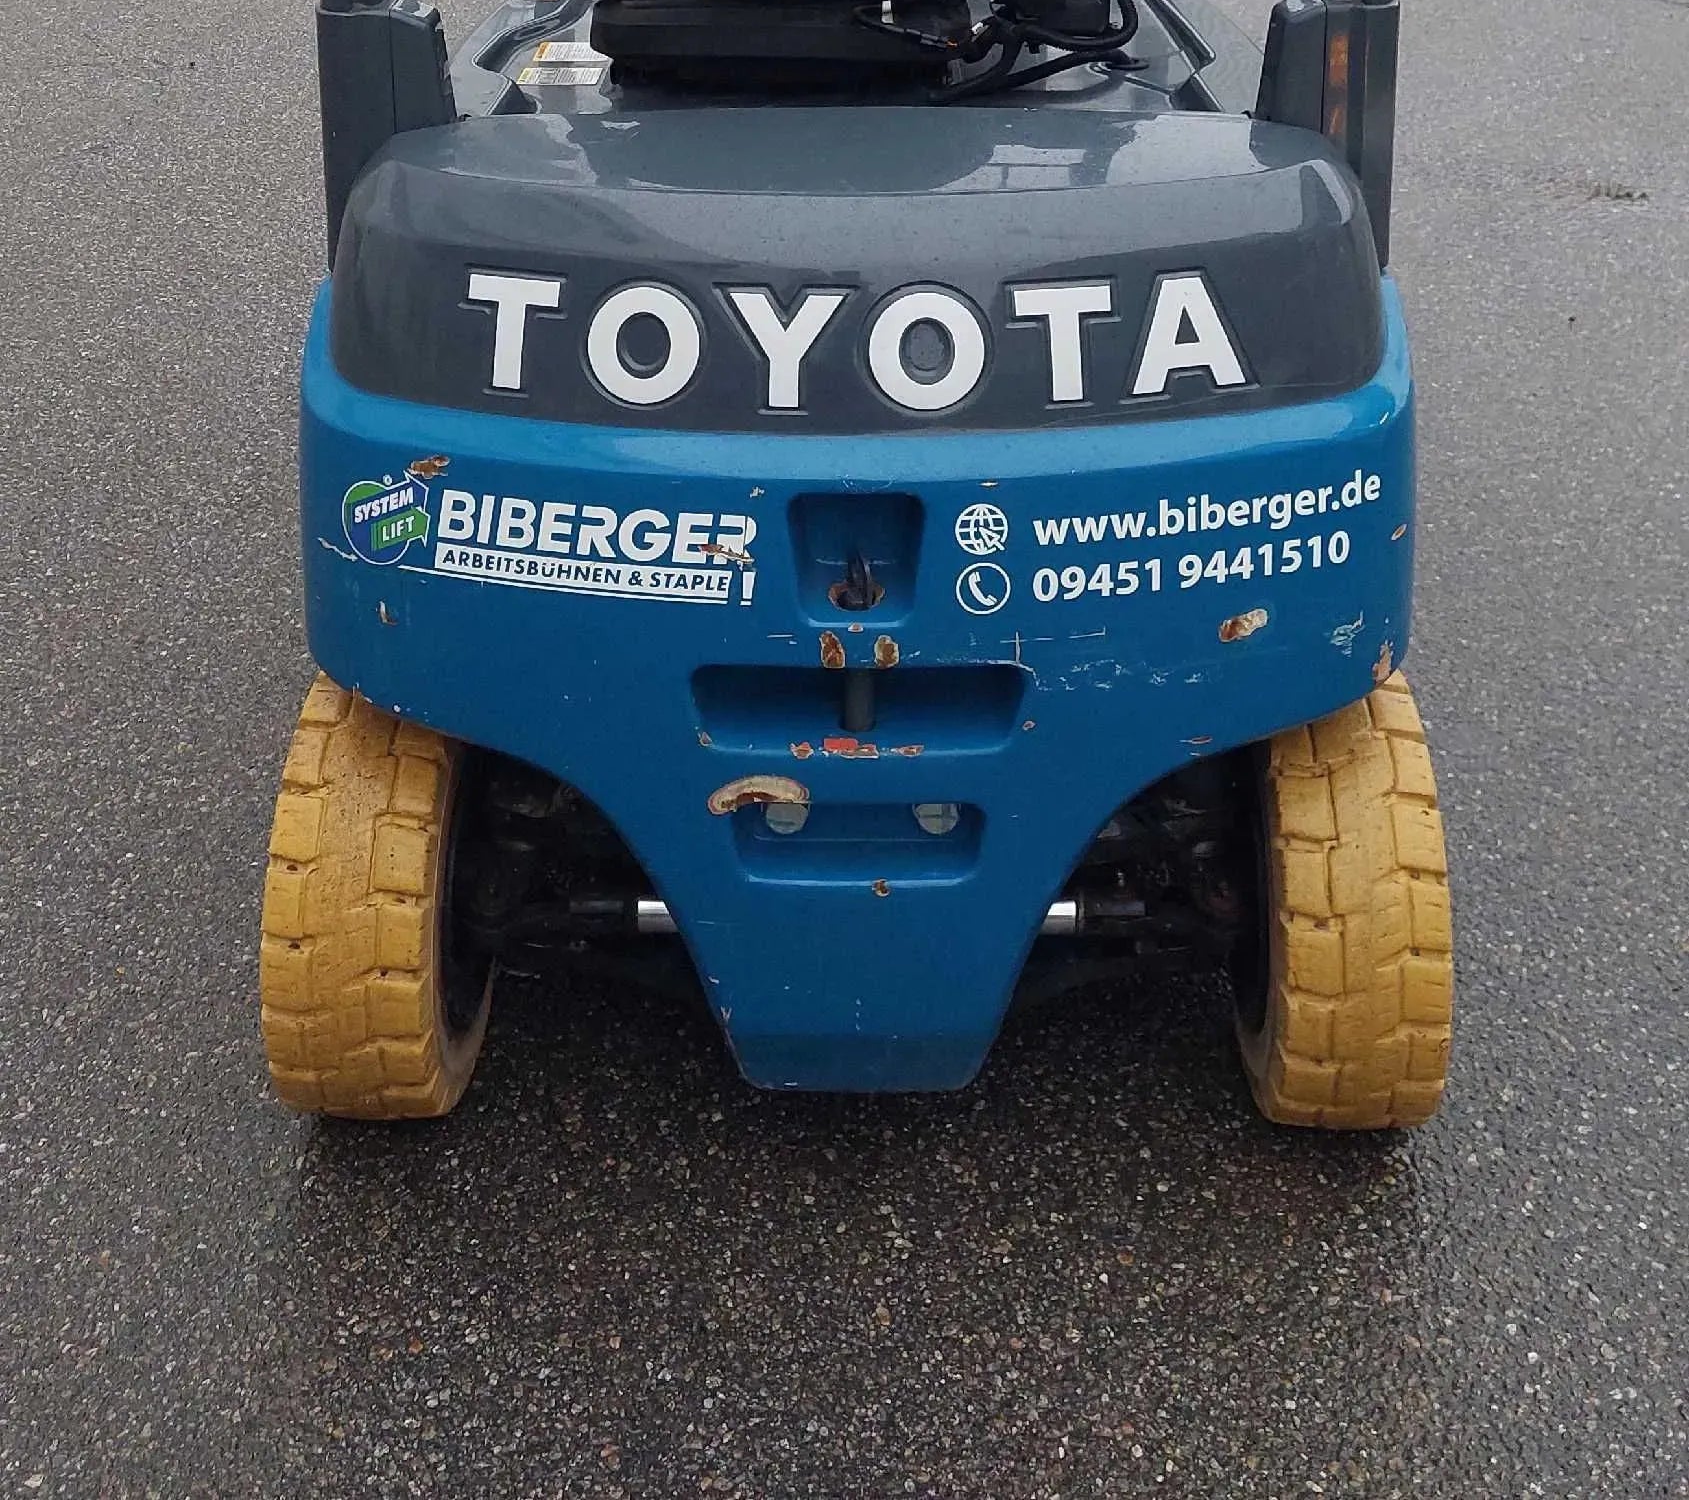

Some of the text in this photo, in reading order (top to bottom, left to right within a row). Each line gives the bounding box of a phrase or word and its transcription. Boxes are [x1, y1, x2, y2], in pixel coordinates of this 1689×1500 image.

[468, 274, 1246, 412] TOYOTA
[354, 487, 415, 524] SYSTEM
[382, 515, 415, 543] LIFT
[438, 489, 757, 566] BIBERGER
[1033, 469, 1382, 546] www.biberger.de
[442, 549, 622, 584] ARBEITSBÜHNEN
[628, 570, 644, 588] &
[1032, 530, 1351, 602] 09451 9441510
